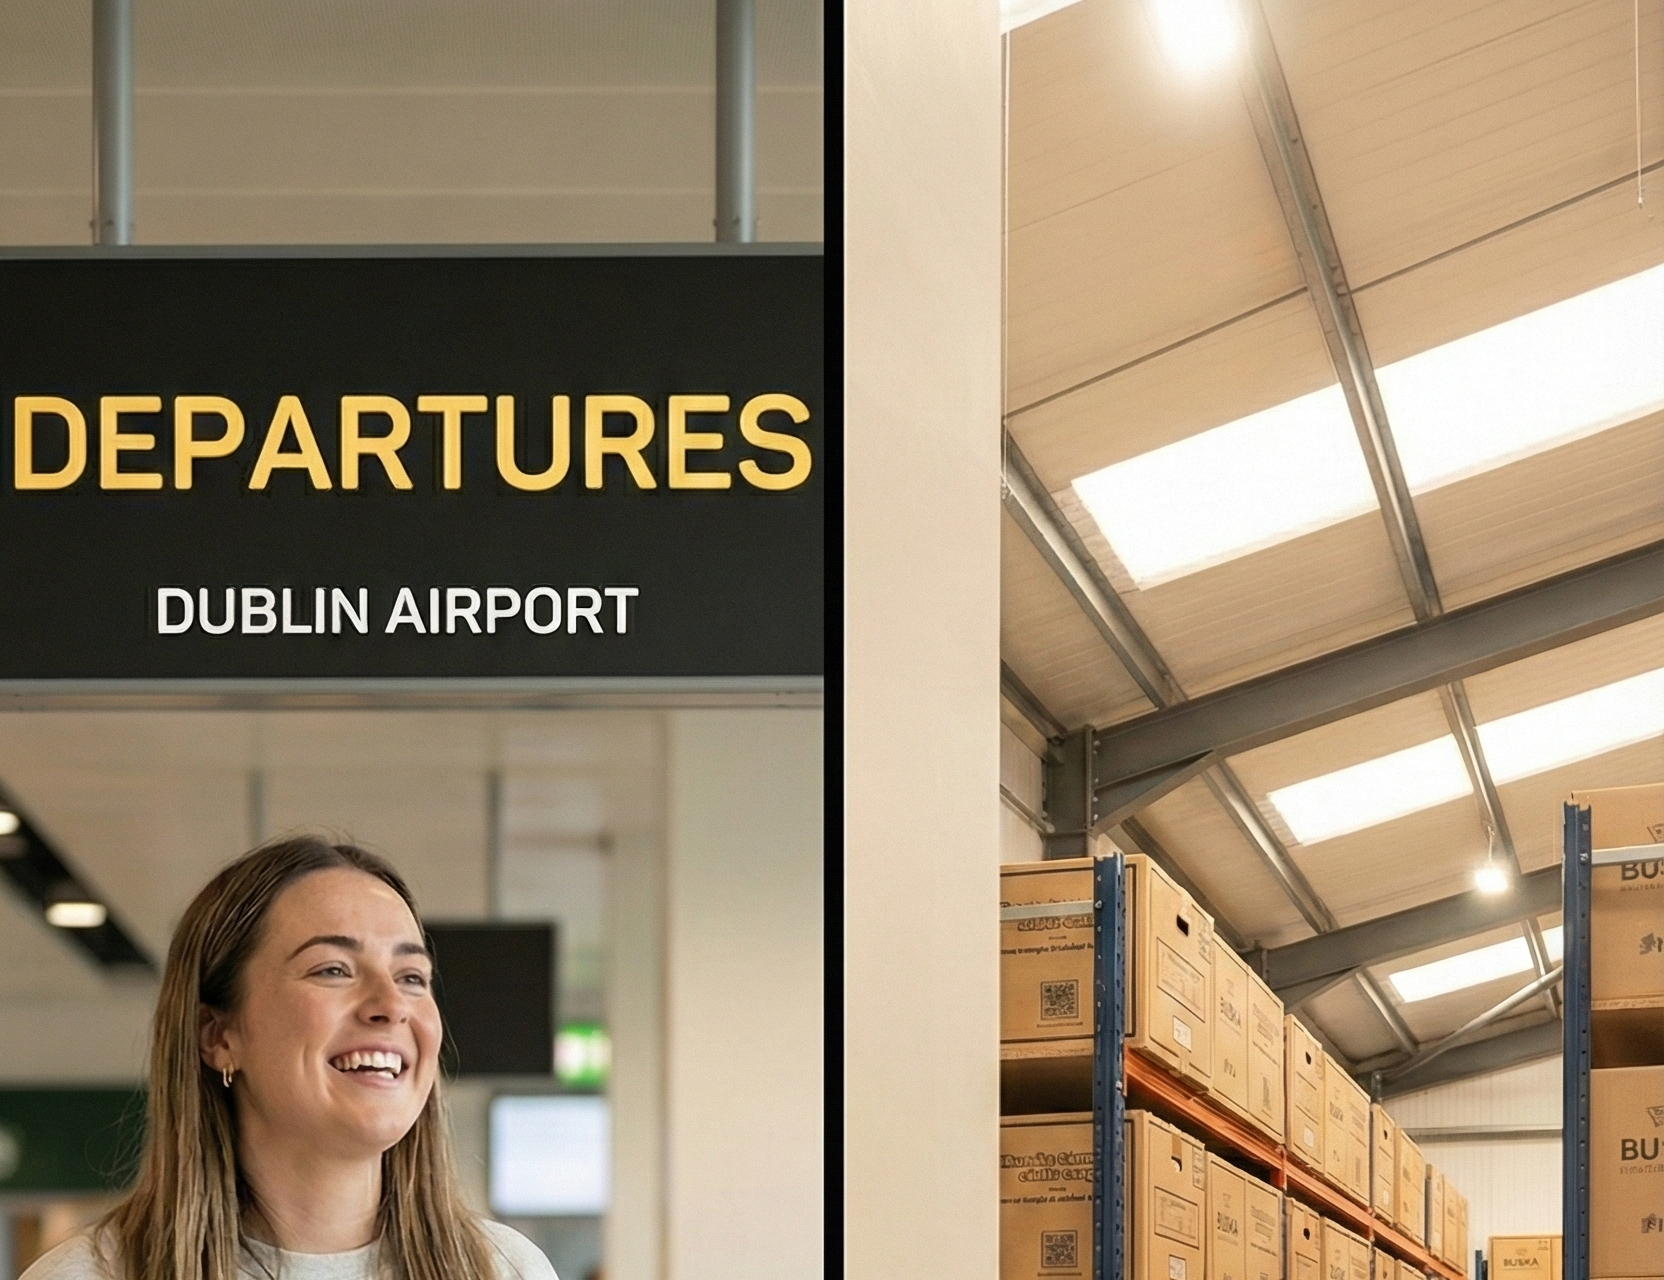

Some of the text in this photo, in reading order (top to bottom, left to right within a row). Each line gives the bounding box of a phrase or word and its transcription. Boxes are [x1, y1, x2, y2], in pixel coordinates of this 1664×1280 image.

[14, 394, 812, 490] DEPARTURES
[157, 586, 639, 635] DUBLIN AIRPORT
[1621, 862, 1664, 881] BU
[1621, 1137, 1664, 1161] BU
